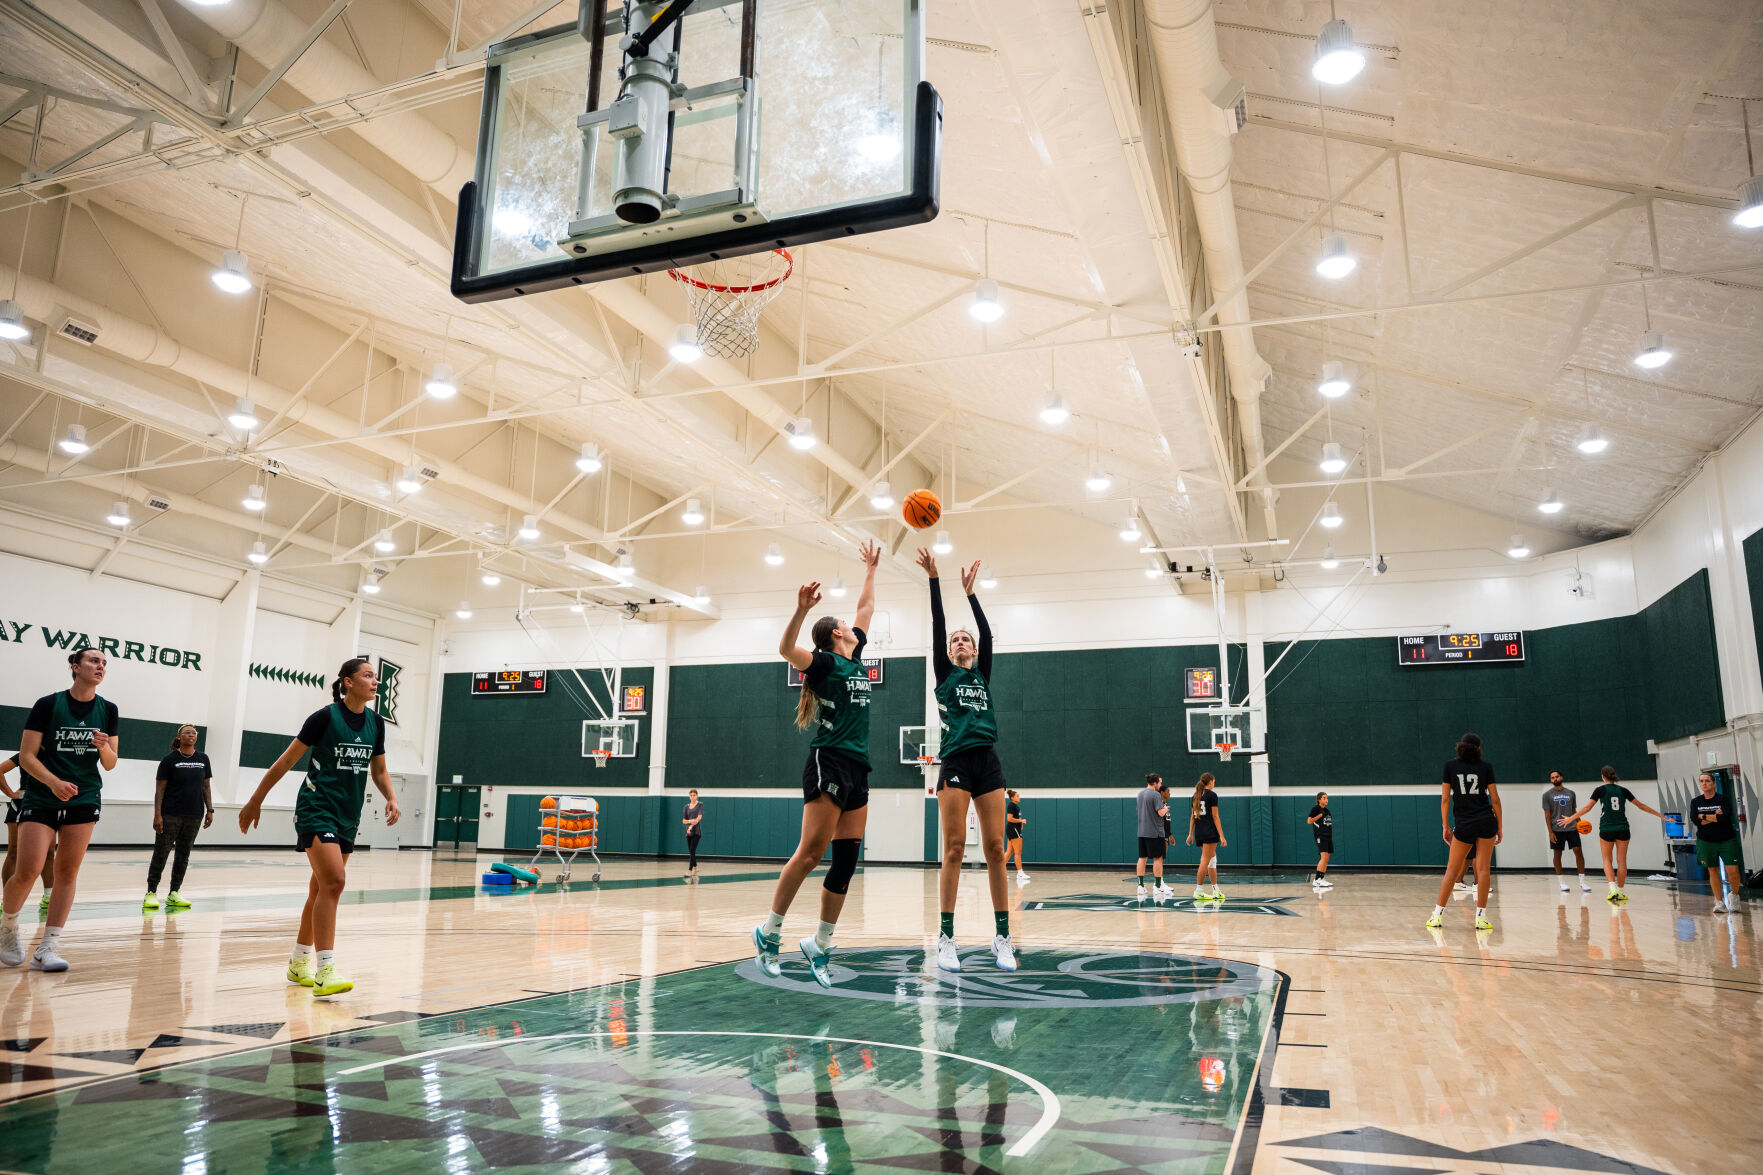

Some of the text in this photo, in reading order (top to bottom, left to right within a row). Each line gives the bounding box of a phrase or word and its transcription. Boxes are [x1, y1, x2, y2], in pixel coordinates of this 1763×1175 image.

[1403, 637, 1425, 645] HOME
[1449, 634, 1479, 647] 9:25
[1493, 633, 1517, 641] GUEST
[41, 626, 202, 671] WARRIOR
[1412, 648, 1426, 659] 11
[1468, 650, 1472, 659] 1
[1505, 643, 1518, 656] 18
[502, 672, 520, 681] 9:25
[868, 668, 879, 680] 18
[479, 681, 488, 690] 11
[533, 679, 543, 689] 18
[1192, 680, 1211, 697] 30
[626, 696, 641, 711] 30
[1456, 773, 1480, 795] 12
[1610, 796, 1620, 811] 8
